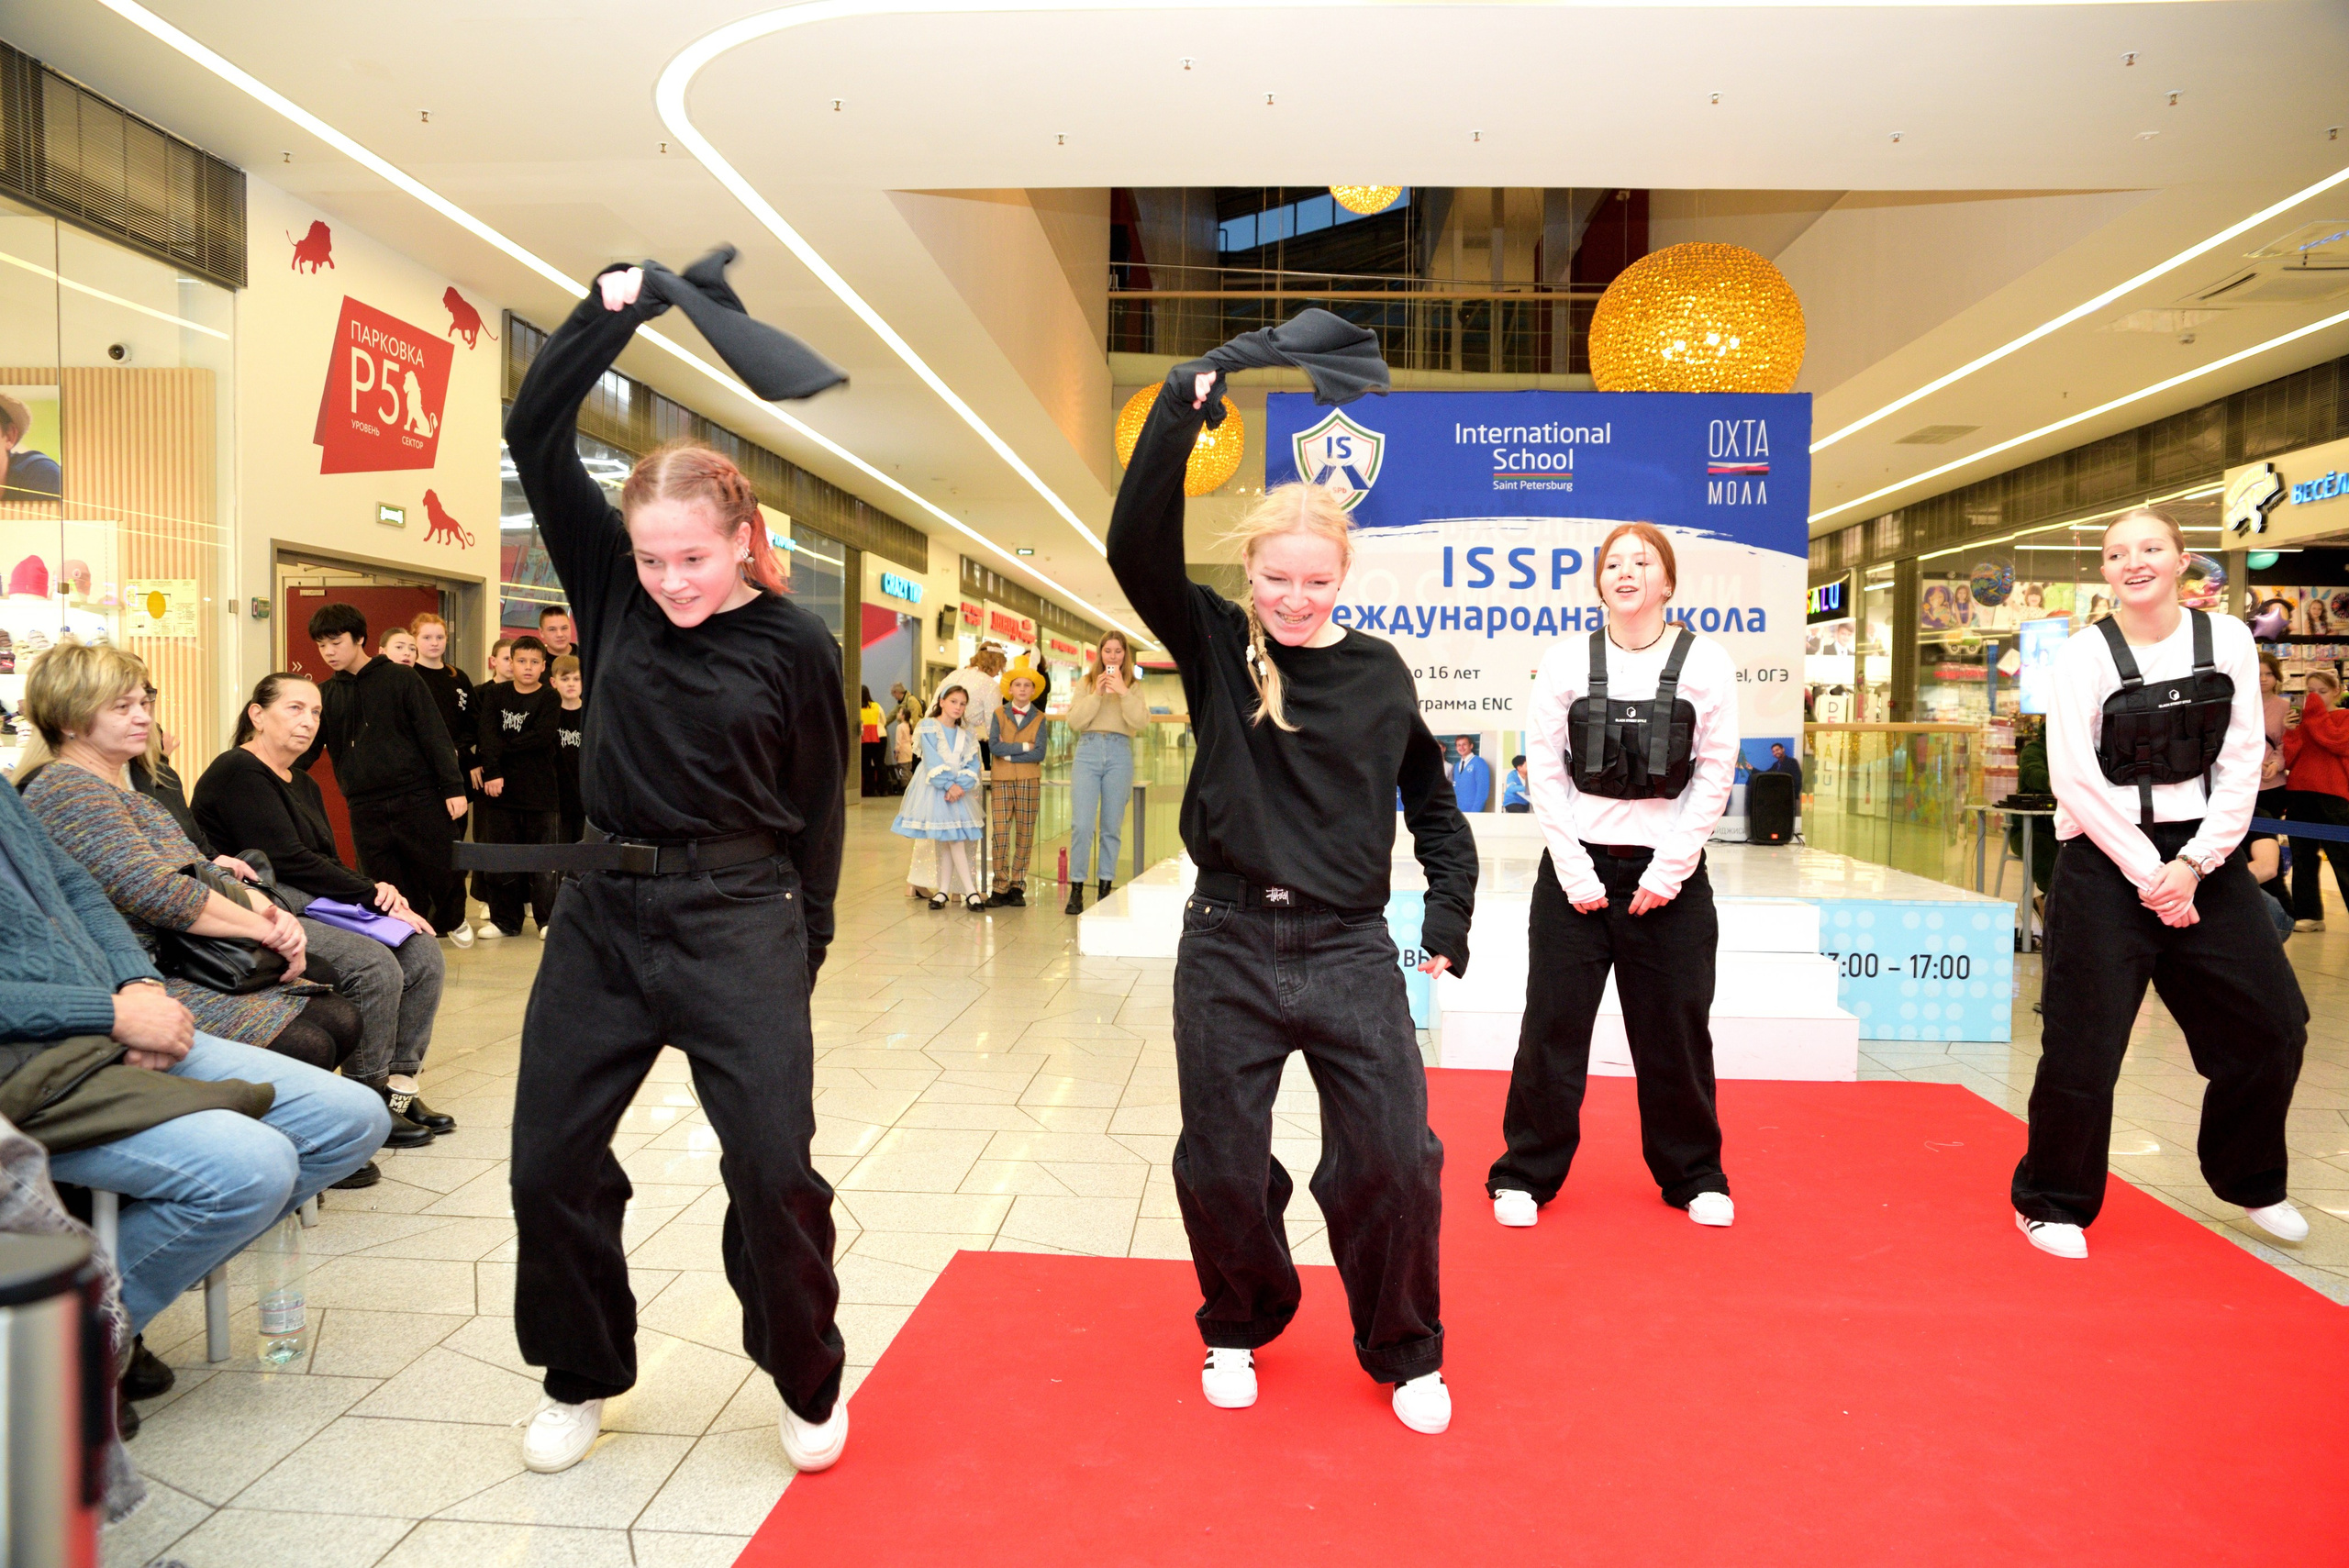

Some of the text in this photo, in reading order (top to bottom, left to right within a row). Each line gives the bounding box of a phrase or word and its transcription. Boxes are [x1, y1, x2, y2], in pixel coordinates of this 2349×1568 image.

[351, 319, 425, 369] ПАРКОВКА
[351, 419, 381, 438] УРОВЕНЬ
[1454, 421, 1612, 445] International
[1709, 418, 1770, 458] ОХТА
[401, 436, 424, 450] СЕКТОР
[1327, 436, 1353, 460] IS
[1492, 447, 1575, 471] School
[1492, 480, 1574, 493] Saint Petersburg
[1708, 481, 1768, 506] МОЛЛ
[2290, 470, 2349, 506] ВЕСЁЛ
[1442, 545, 1601, 590] ISSP
[1412, 665, 1481, 680] о 16 лет
[1757, 668, 1789, 683] ОГЭ
[1482, 697, 1513, 711] ENC
[1820, 952, 1879, 978] :00
[1909, 954, 1971, 980] 17:00
